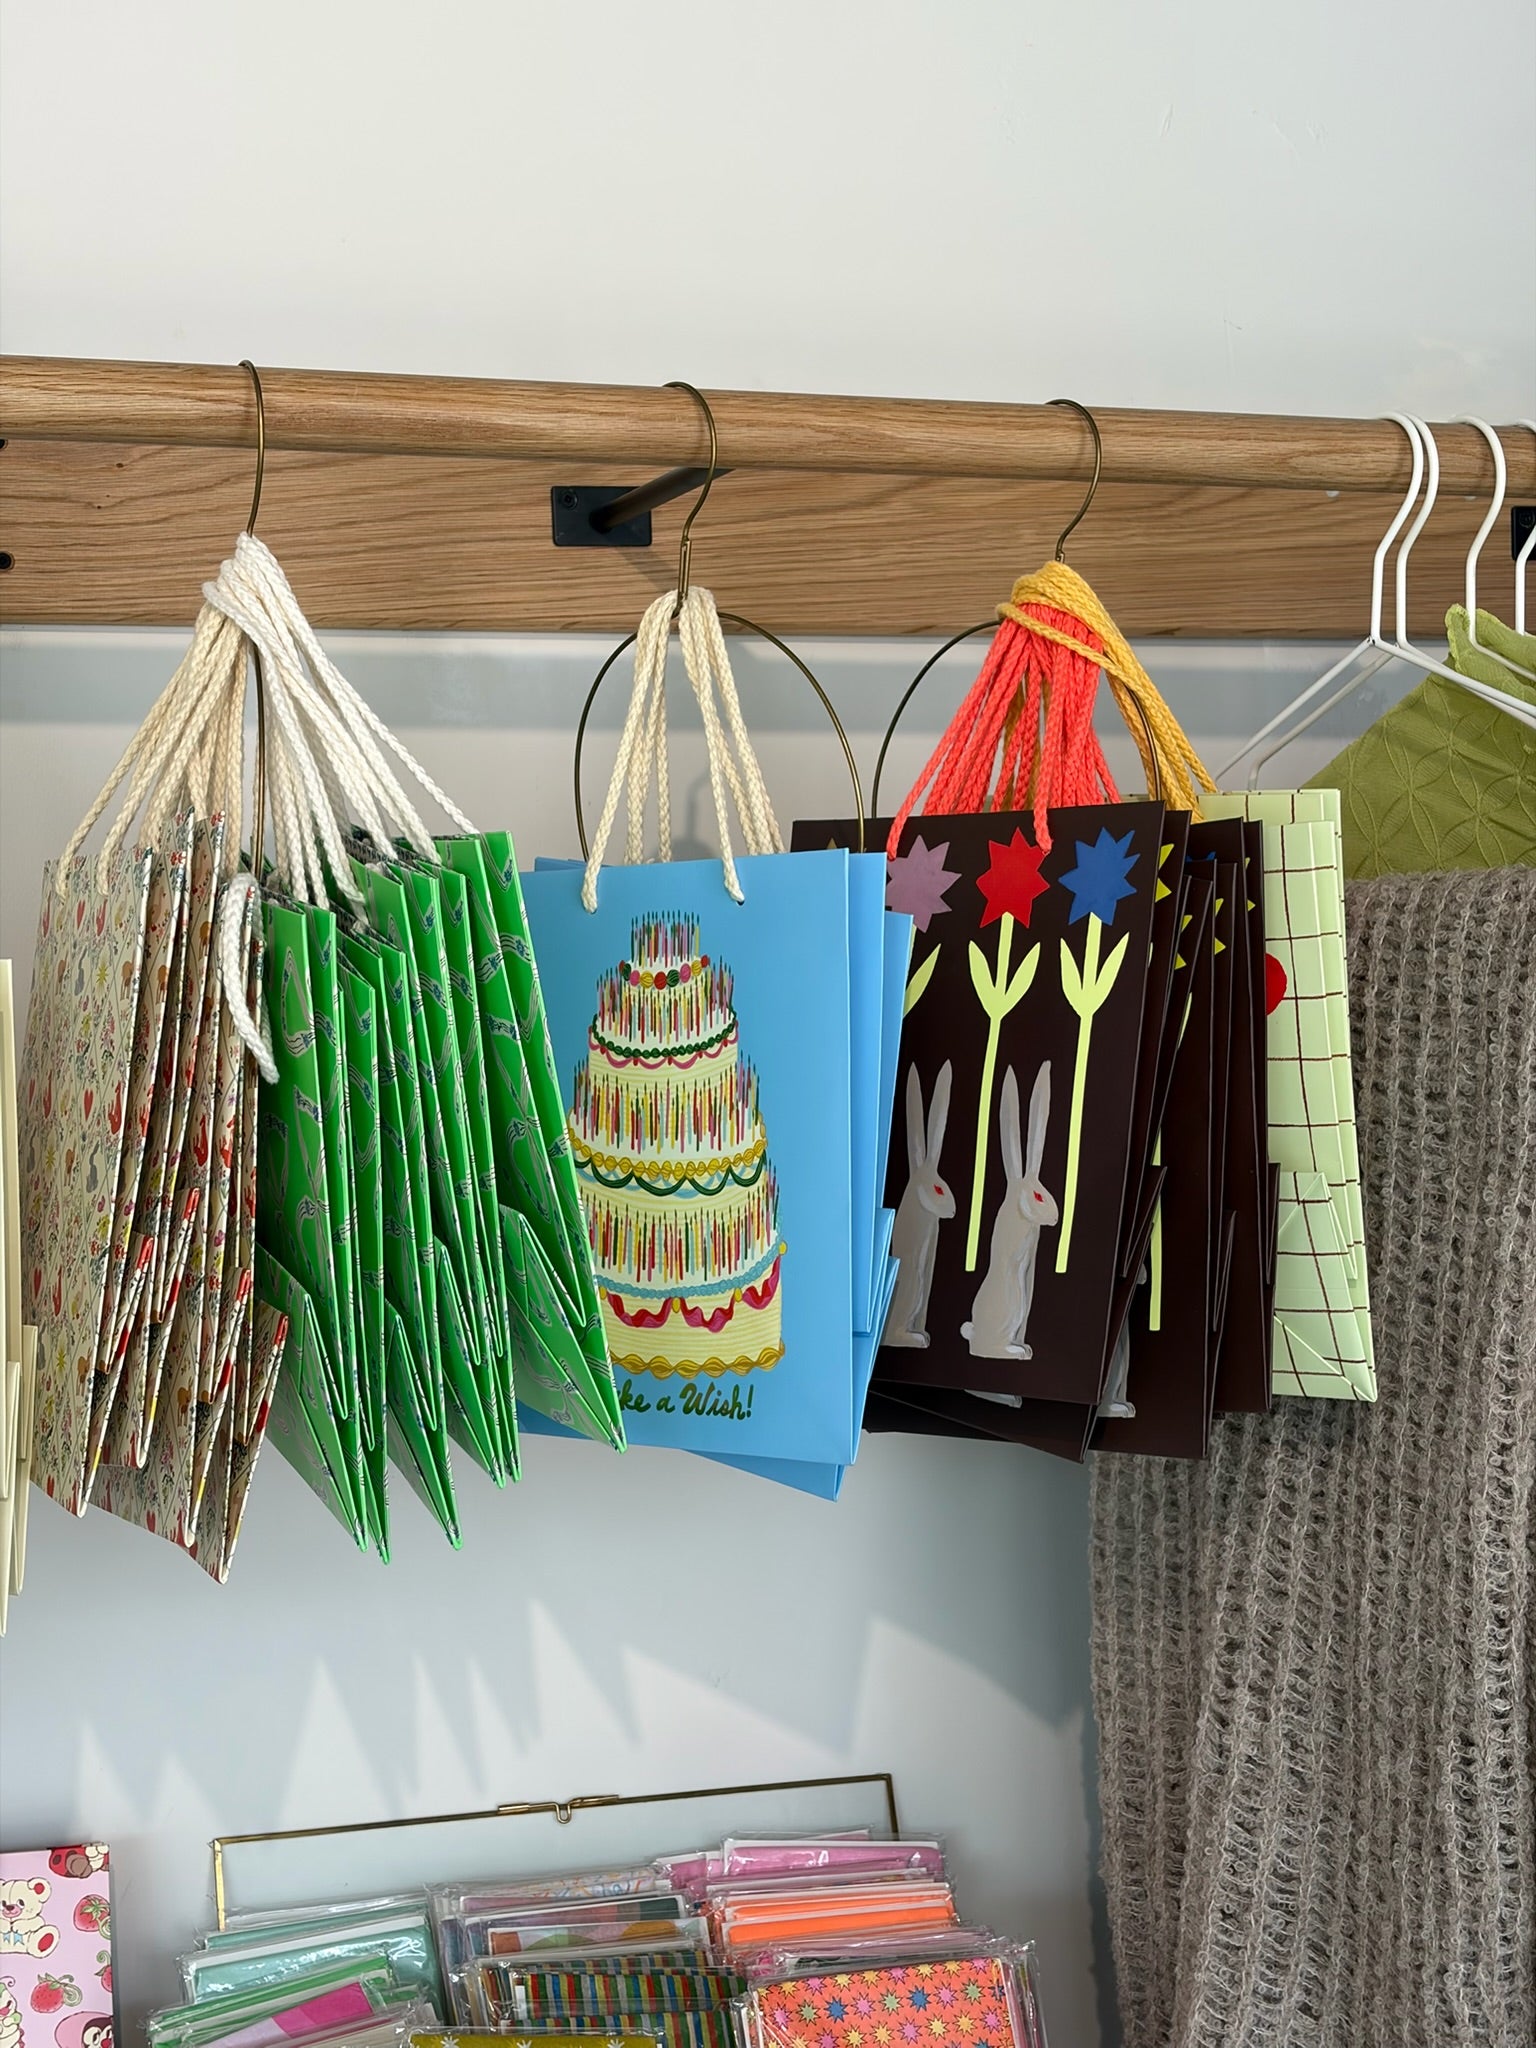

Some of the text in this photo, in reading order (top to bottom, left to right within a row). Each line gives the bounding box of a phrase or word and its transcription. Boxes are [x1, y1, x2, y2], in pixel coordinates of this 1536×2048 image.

[618, 1378, 754, 1420] ke a Wish!
